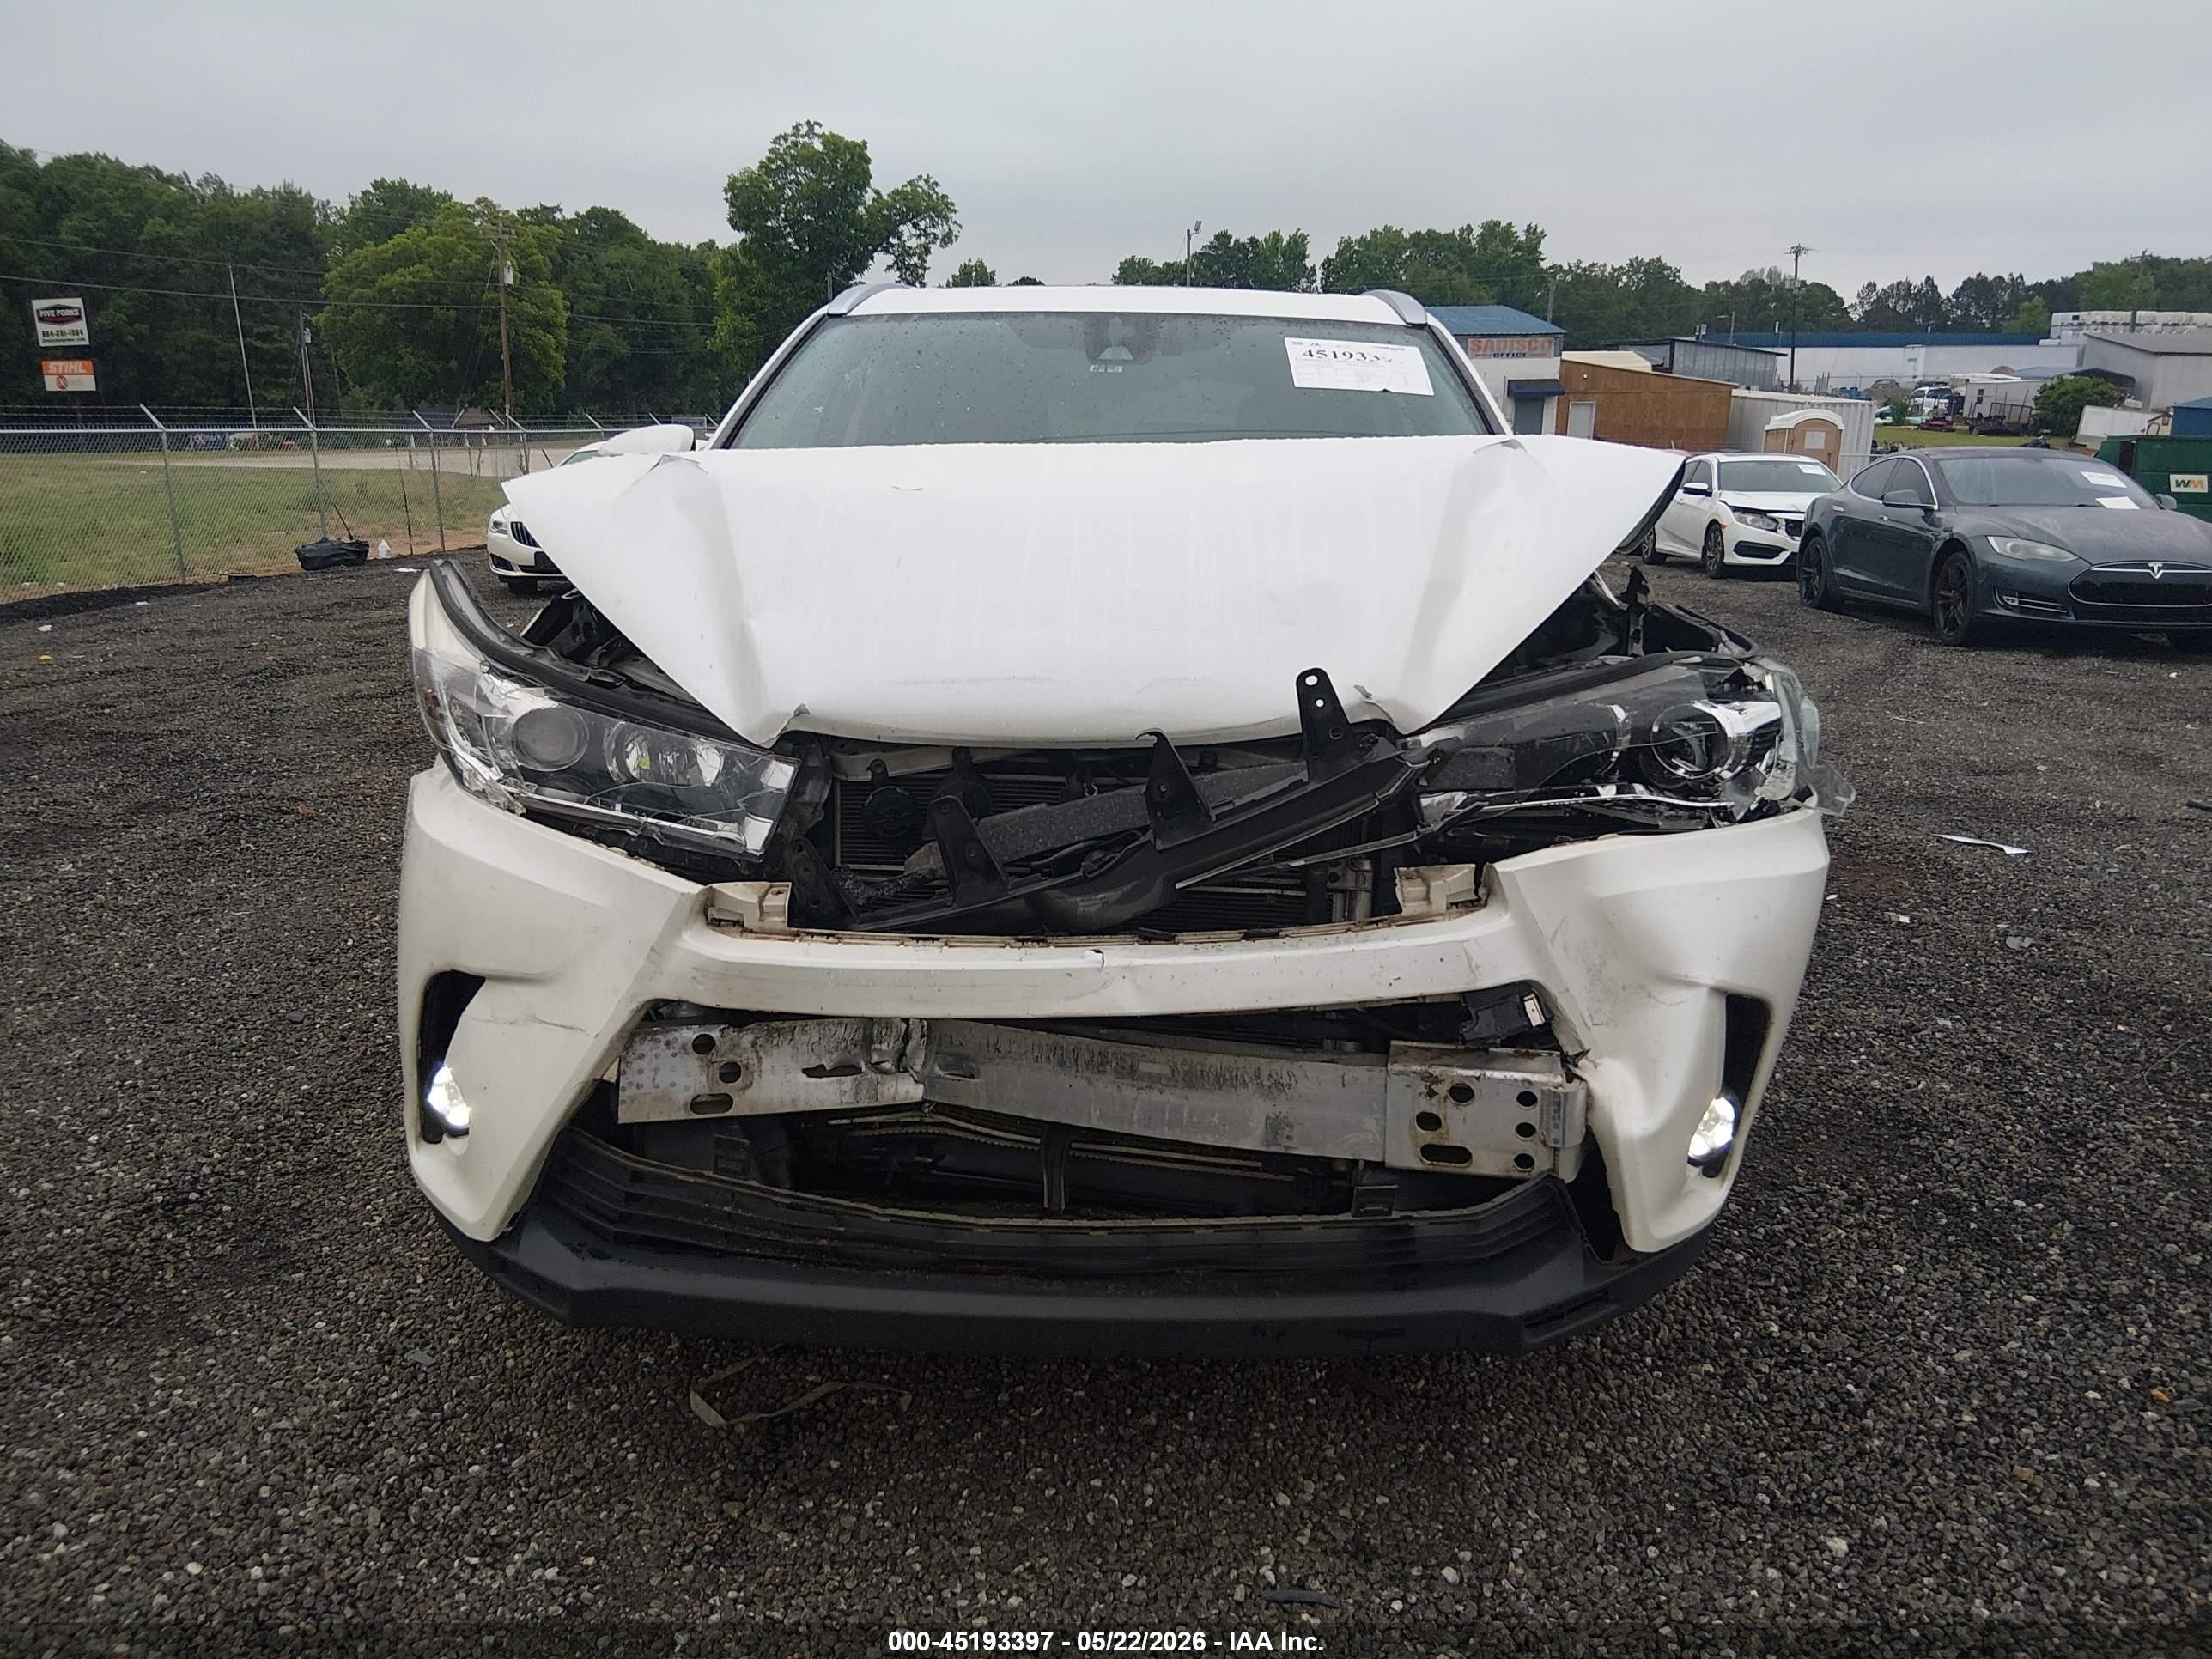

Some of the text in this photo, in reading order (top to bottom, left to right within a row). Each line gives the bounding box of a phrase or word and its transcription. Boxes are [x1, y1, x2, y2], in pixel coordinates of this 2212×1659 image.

[1470, 338, 1553, 352] SADISCO
[48, 361, 86, 374] STIHL
[2175, 479, 2203, 489] WM
